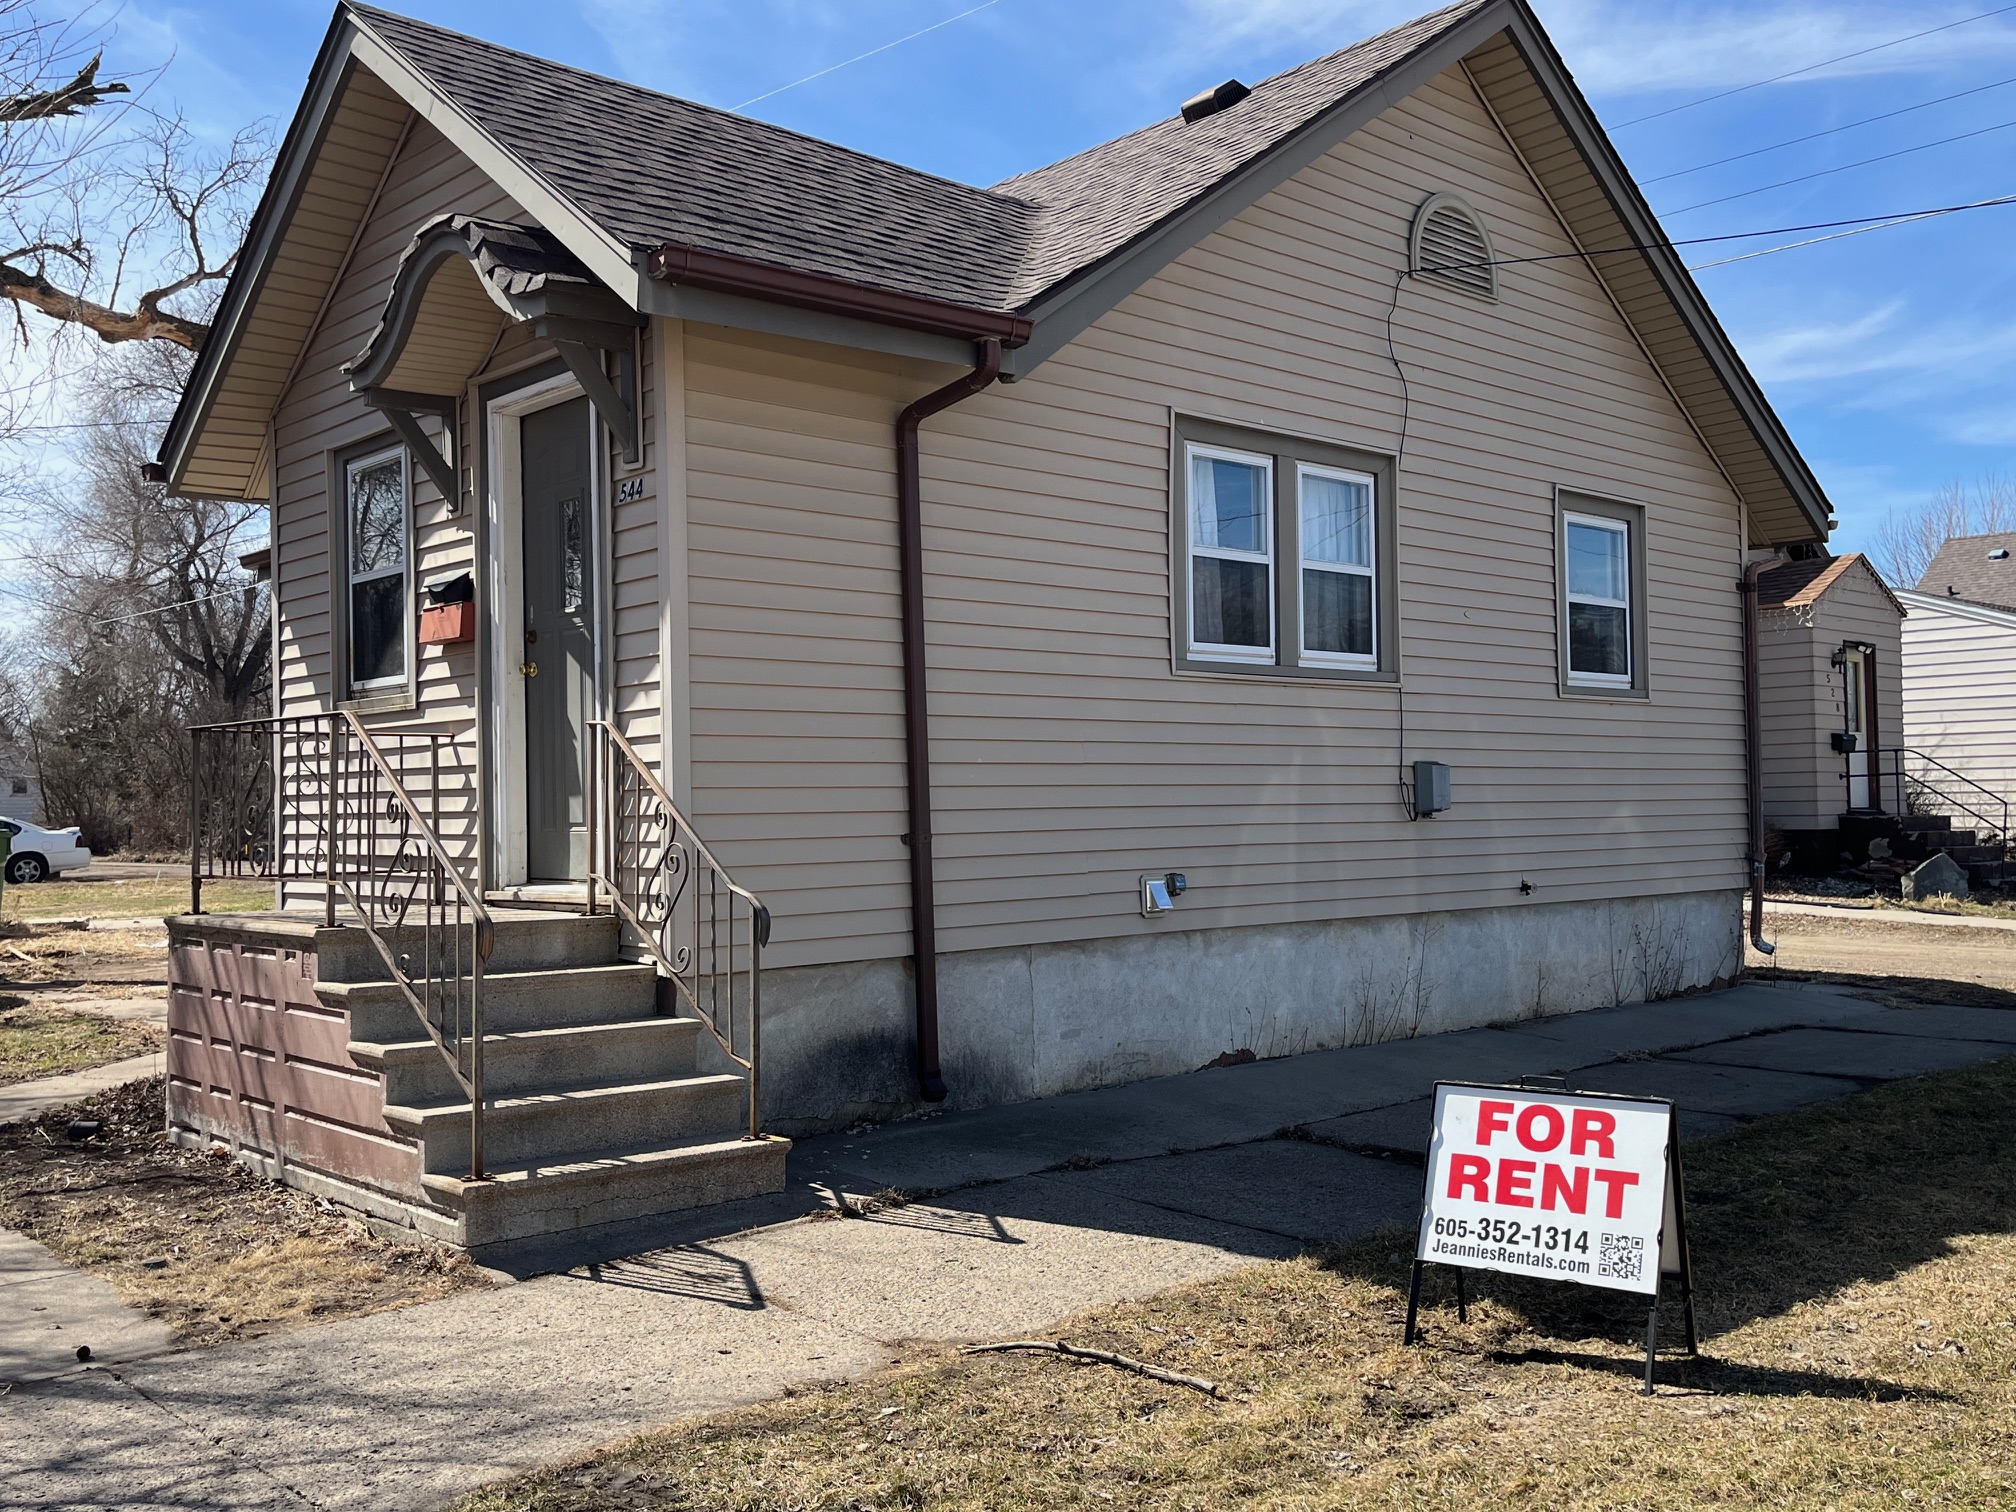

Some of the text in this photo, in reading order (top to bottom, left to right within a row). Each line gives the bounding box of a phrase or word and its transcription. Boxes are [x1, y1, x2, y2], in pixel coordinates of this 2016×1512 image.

[619, 478, 643, 503] 544
[1826, 673, 1840, 713] 528
[1476, 1100, 1616, 1159] FOR
[1446, 1153, 1640, 1219] RENT
[1434, 1216, 1589, 1255] 605-352-1314
[1432, 1238, 1590, 1274] JeanniesRentals.com
